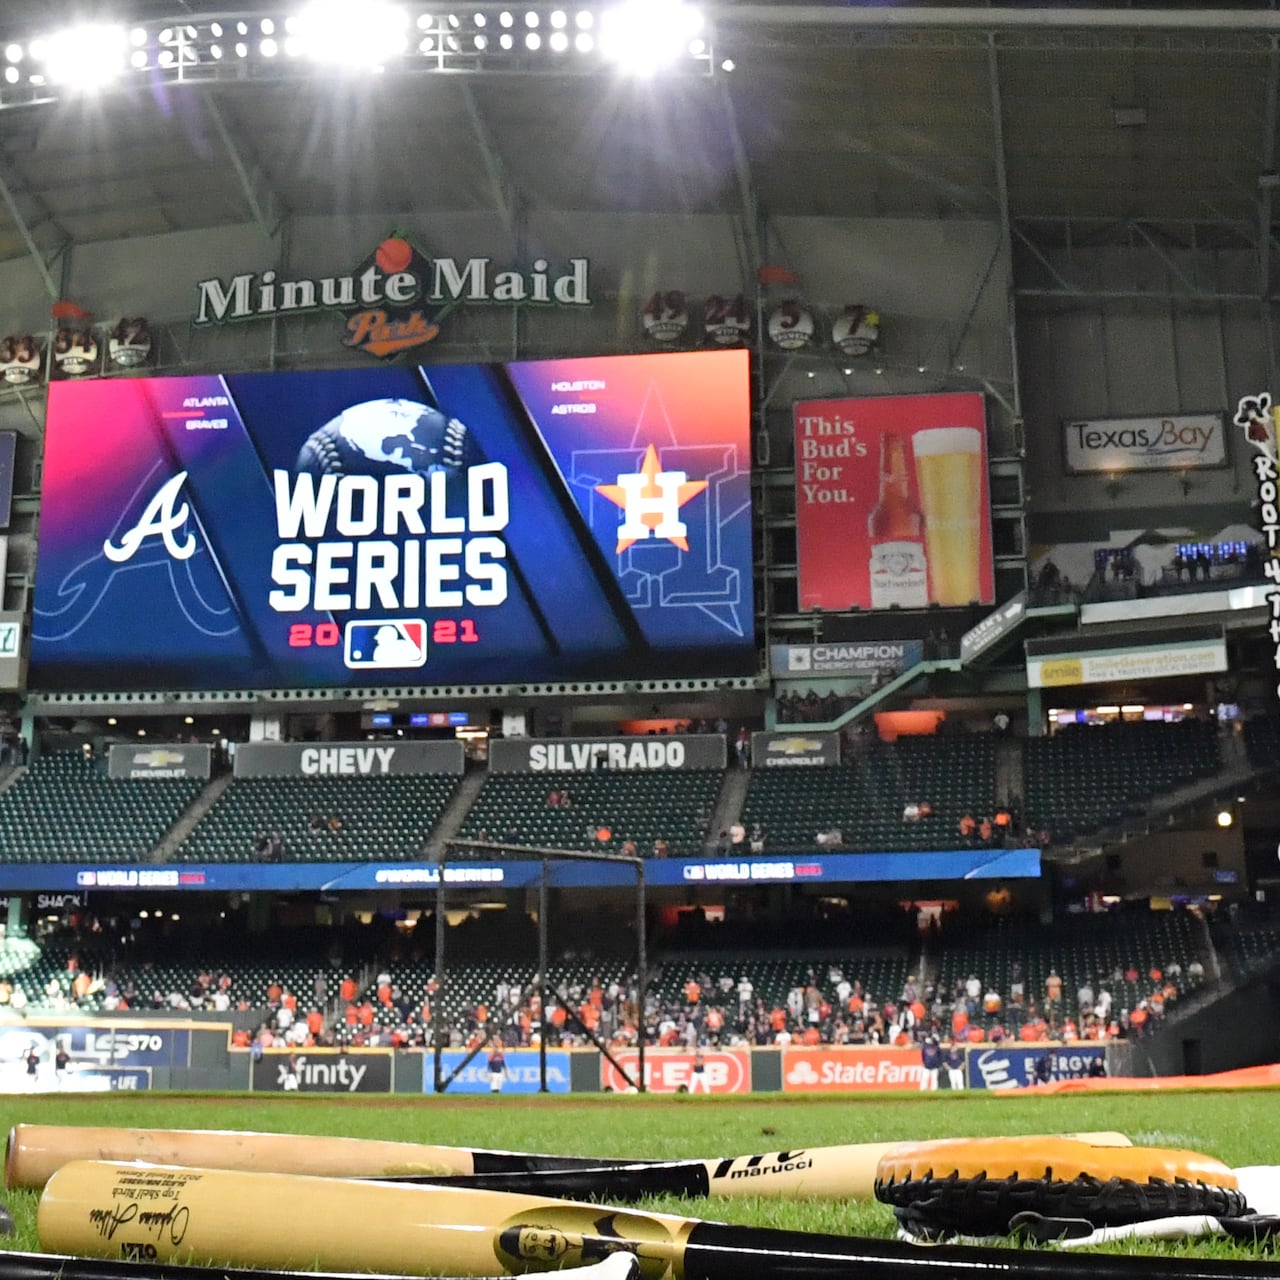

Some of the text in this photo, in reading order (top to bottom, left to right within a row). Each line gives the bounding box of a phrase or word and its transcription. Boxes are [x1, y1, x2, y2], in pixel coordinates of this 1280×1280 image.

[196, 258, 591, 323] Minute Maid
[781, 299, 801, 329] 5
[846, 305, 865, 335] 7
[551, 380, 606, 391] HOUSTON
[183, 396, 229, 407] ATLANTA
[551, 403, 597, 415] ASTROS
[185, 419, 228, 430] BRAVES
[799, 416, 855, 436] This
[1072, 420, 1215, 452] Texas Bay
[802, 437, 867, 459] Bud's
[802, 462, 843, 481] For
[273, 462, 510, 538] WORLD
[803, 484, 856, 504] You.
[269, 537, 508, 612] SERIES
[812, 645, 904, 661] CHAMPION
[1042, 664, 1081, 682] smile
[300, 747, 395, 775] CHEVY
[528, 740, 686, 771] SILVERADO
[766, 756, 826, 766] CHEVROLET
[97, 871, 138, 886] WORLD
[139, 870, 179, 886] SERIES
[375, 868, 504, 883] #WORLSERIES
[704, 863, 750, 880] WORLD
[750, 862, 795, 879] SERIES
[128, 1035, 162, 1051] 370
[625, 1061, 729, 1086] H-EB
[1024, 1056, 1093, 1072] EERGY
[276, 1056, 368, 1092] xfinity
[731, 1156, 814, 1179] marucci
[111, 1187, 181, 1200] Top Shell Birch
